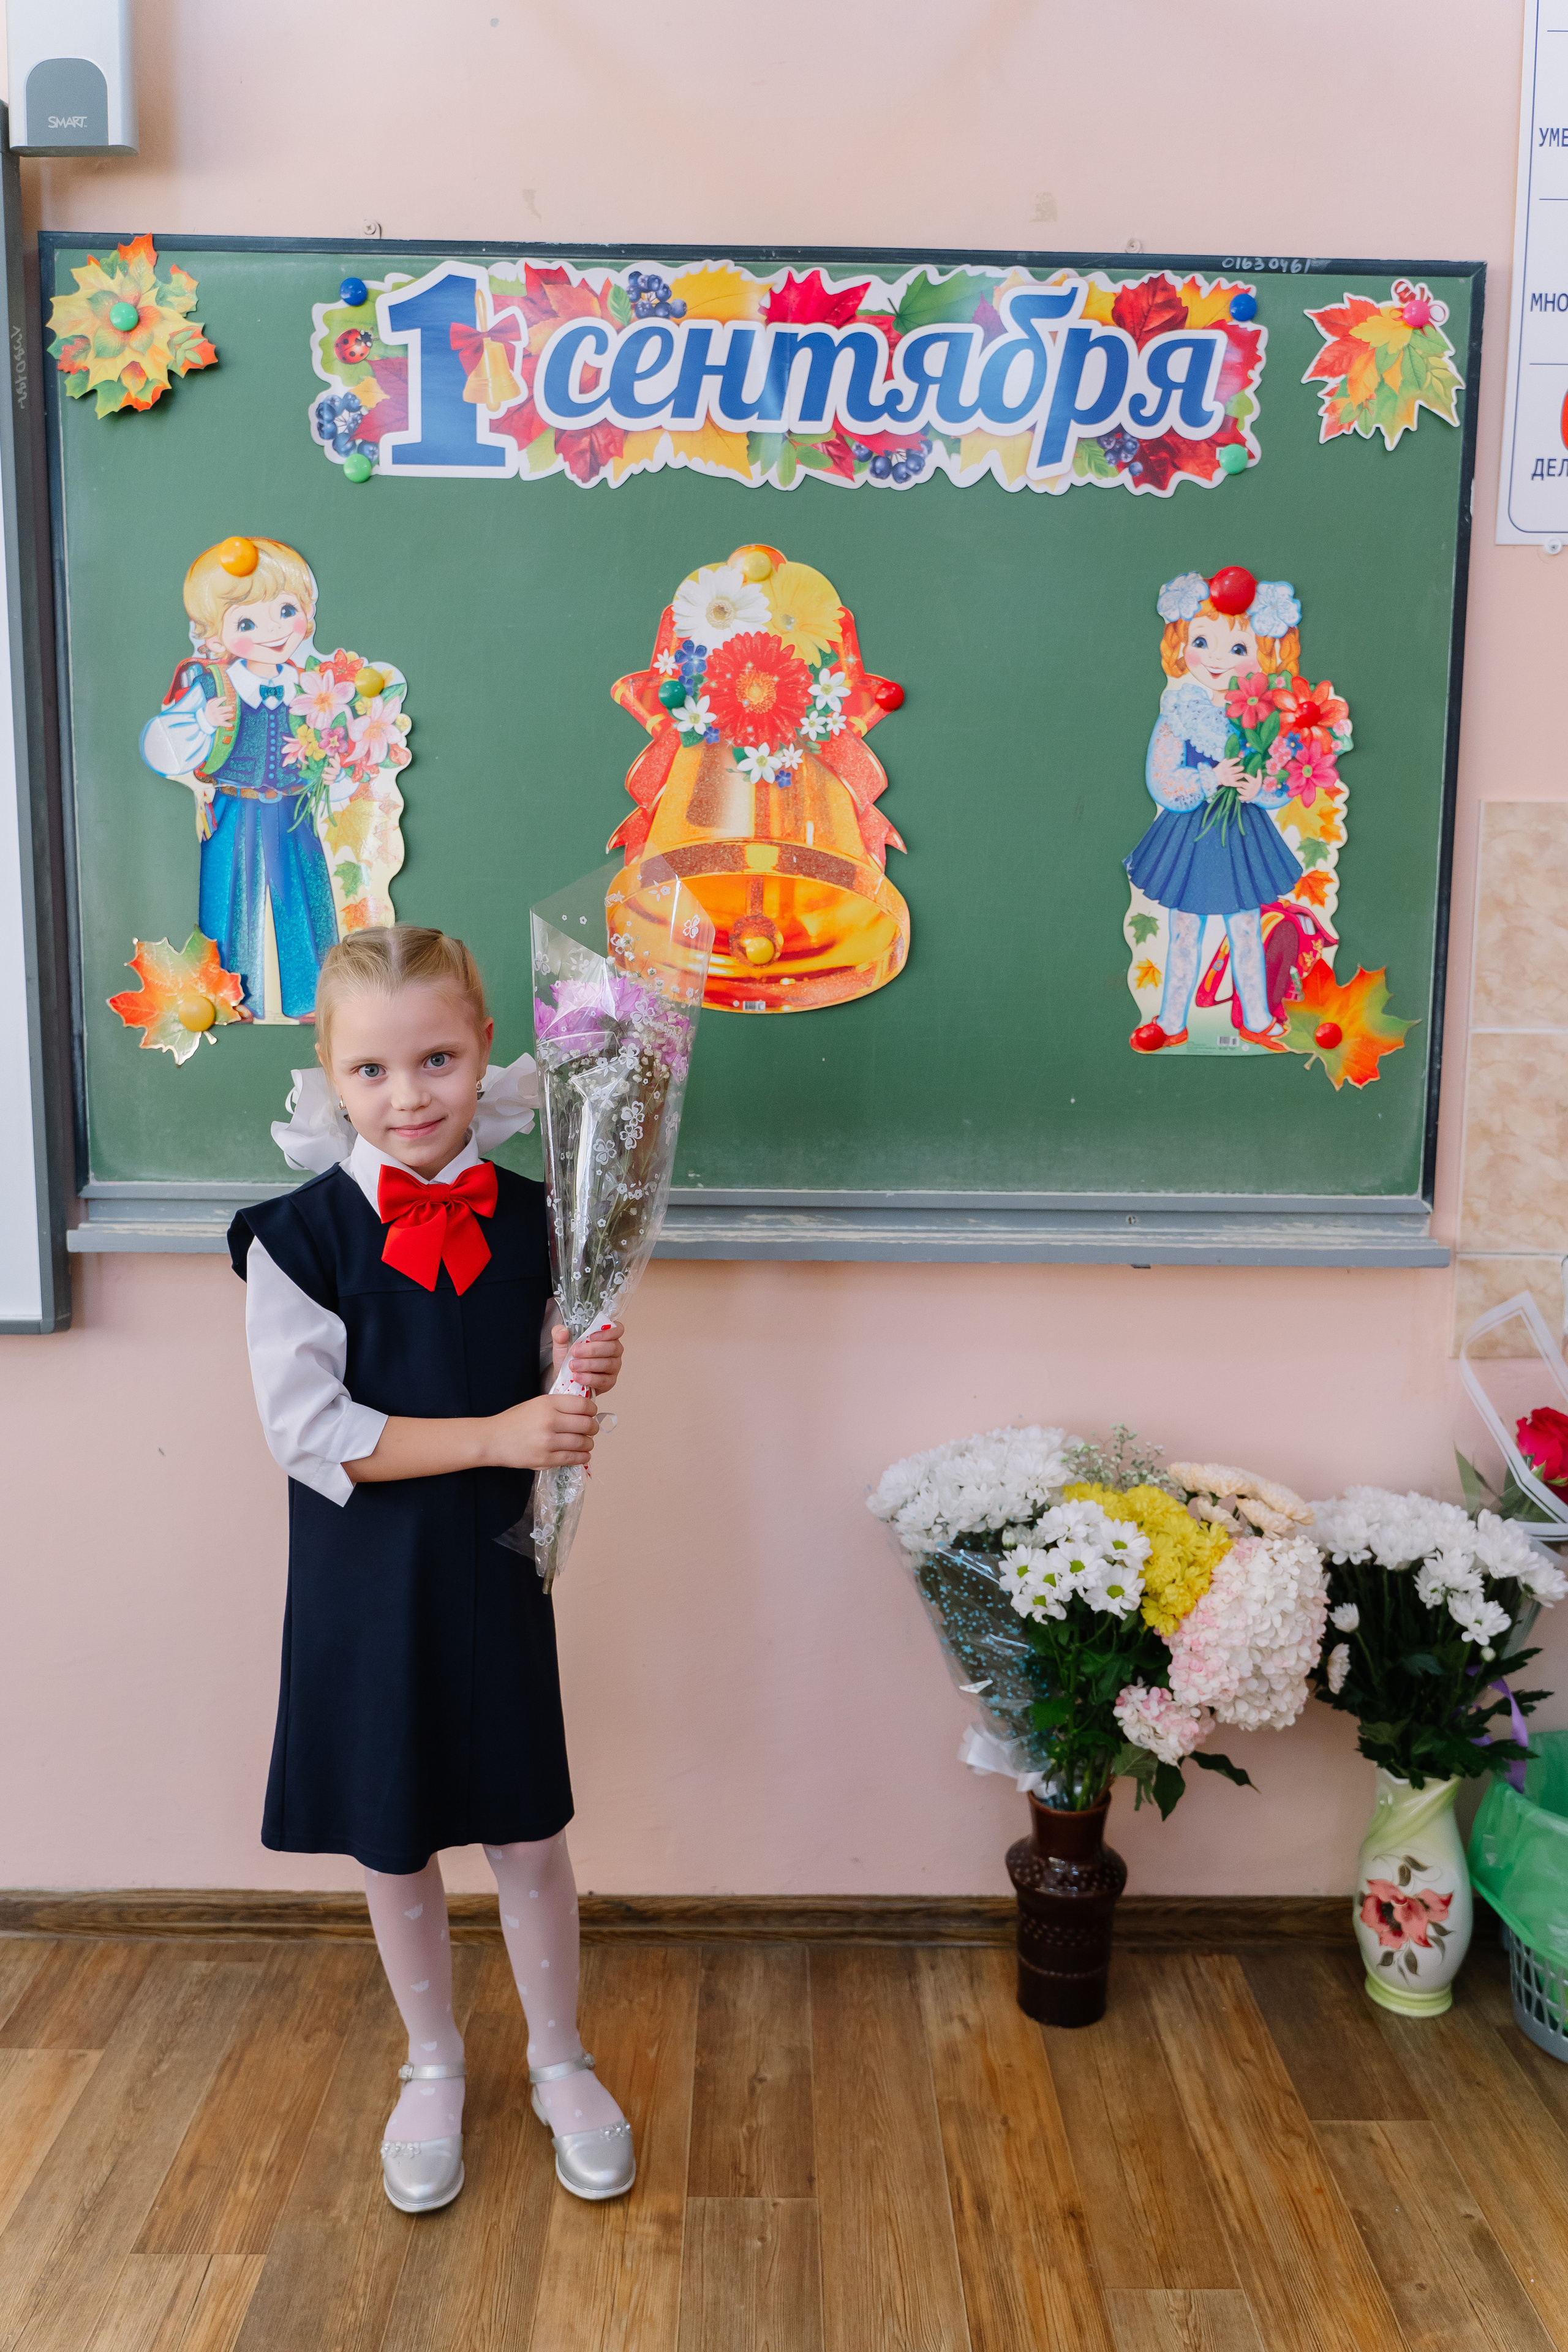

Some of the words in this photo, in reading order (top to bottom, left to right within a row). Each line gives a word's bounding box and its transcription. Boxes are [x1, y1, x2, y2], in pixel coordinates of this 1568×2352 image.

[48, 115, 88, 129] SMART
[388, 274, 507, 467] 1
[544, 286, 1218, 467] сентября
